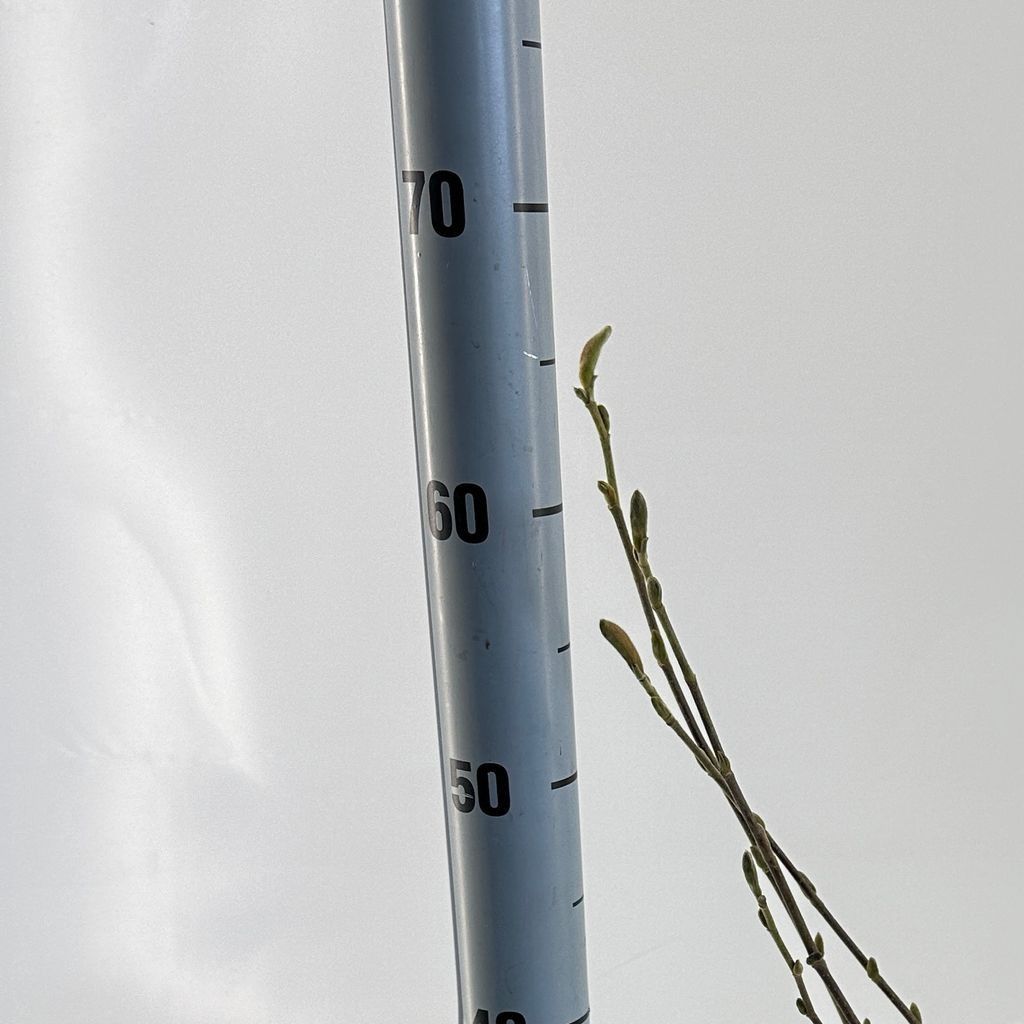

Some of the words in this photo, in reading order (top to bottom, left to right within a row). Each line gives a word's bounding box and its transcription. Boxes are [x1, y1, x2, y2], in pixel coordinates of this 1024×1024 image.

[402, 170, 466, 238] 70
[427, 480, 489, 544] 60
[450, 758, 511, 815] 50
